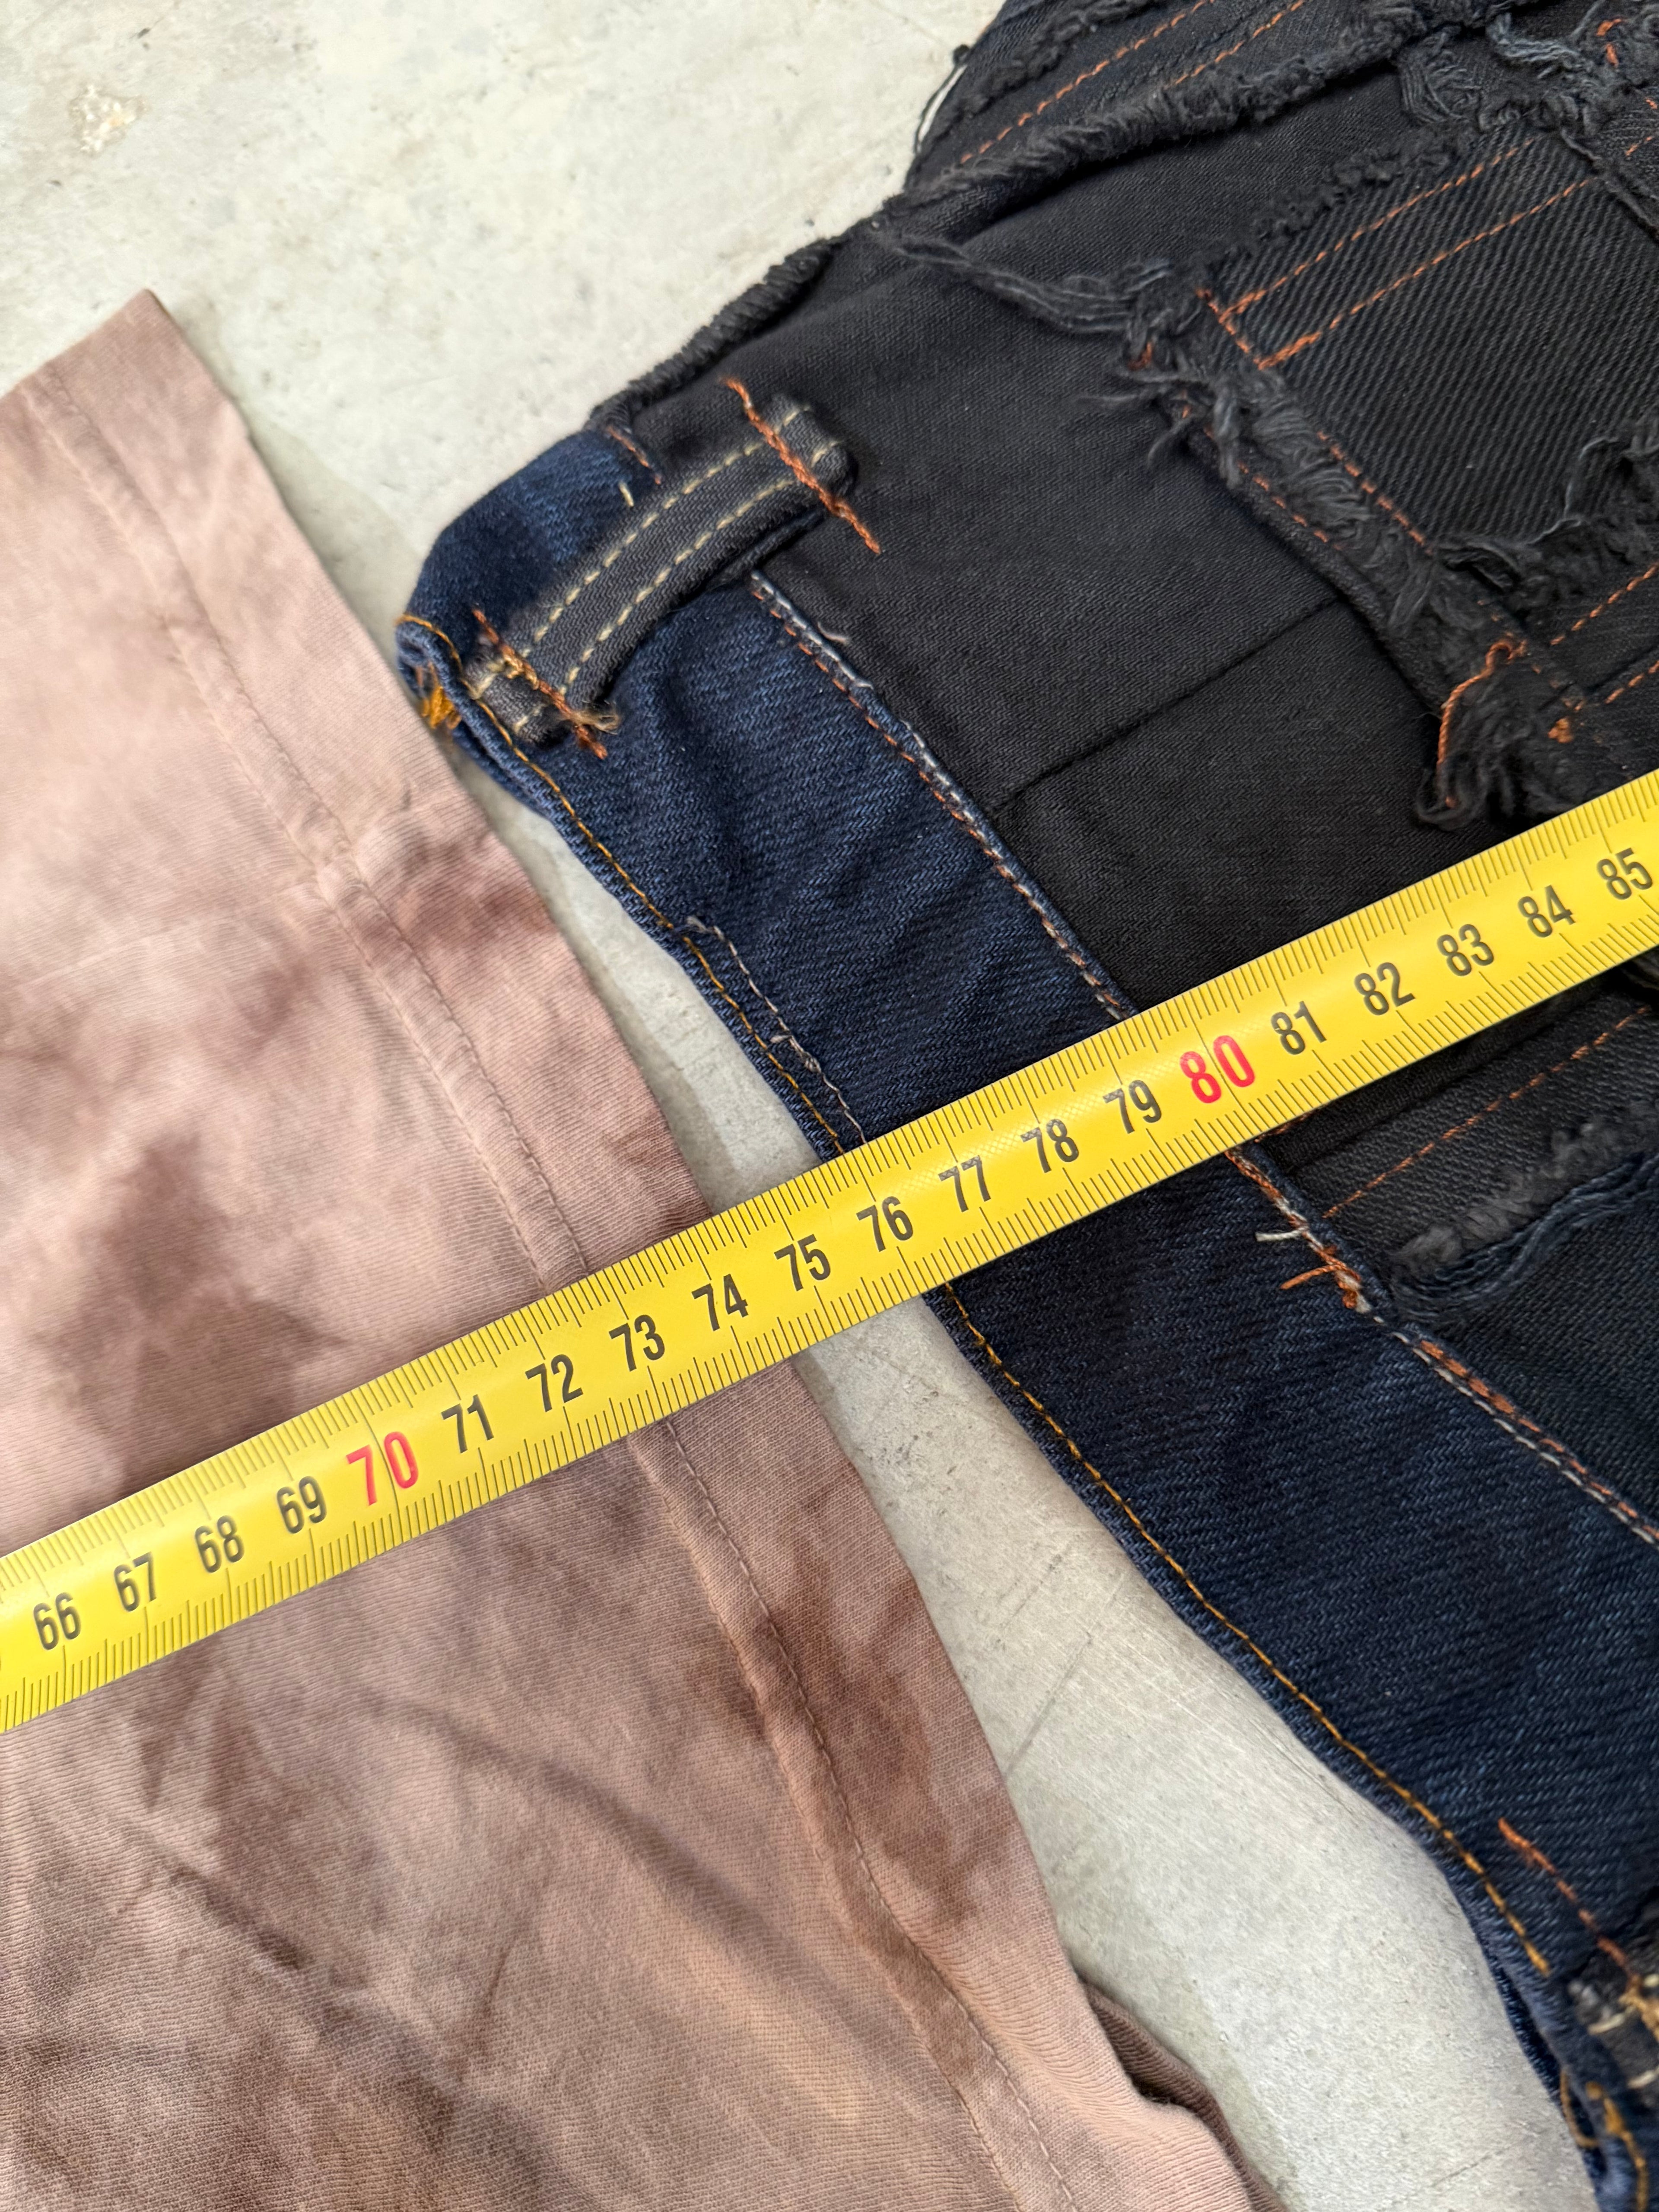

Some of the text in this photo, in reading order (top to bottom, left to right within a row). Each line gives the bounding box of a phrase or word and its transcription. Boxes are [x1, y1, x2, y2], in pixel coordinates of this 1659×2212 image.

[33, 848, 1653, 1650] 66 67 68 69 70 71 72 73 74 75 76 77 78 79 80 81 82 83 84 85
